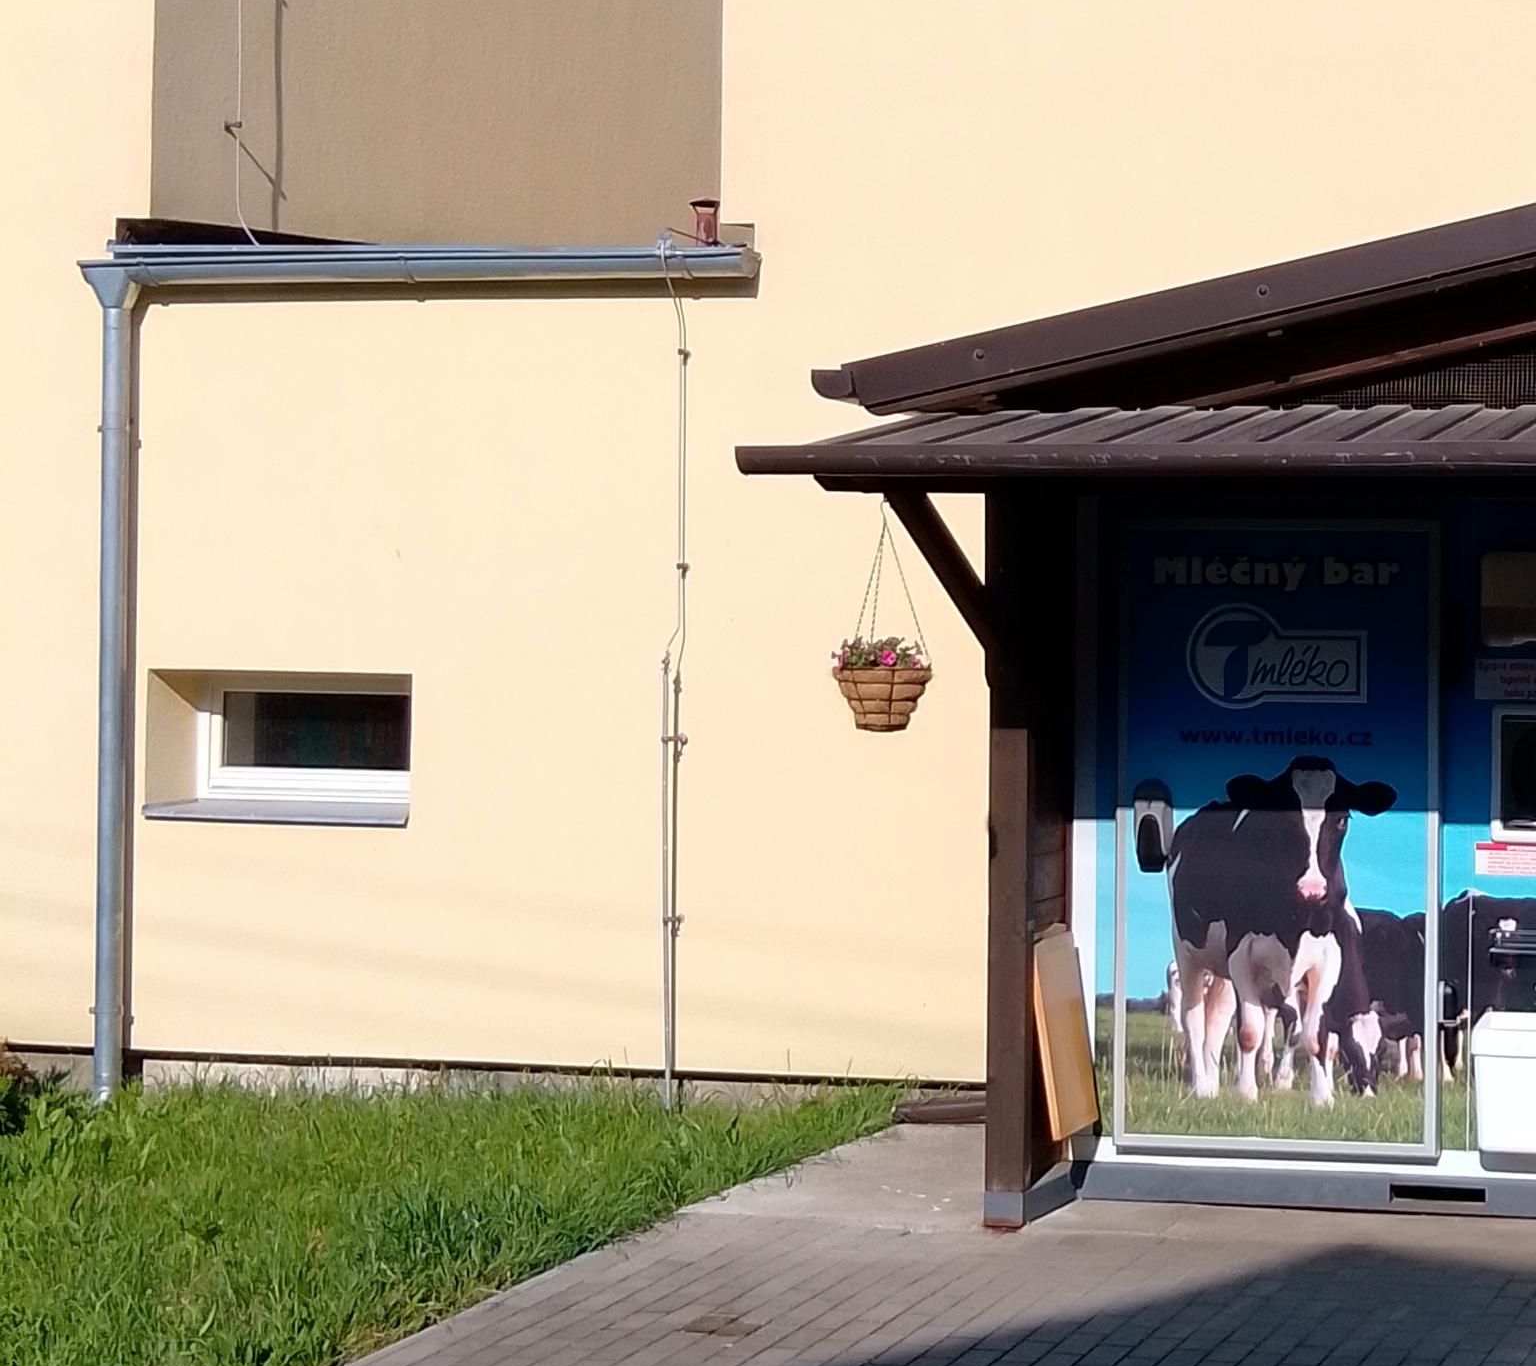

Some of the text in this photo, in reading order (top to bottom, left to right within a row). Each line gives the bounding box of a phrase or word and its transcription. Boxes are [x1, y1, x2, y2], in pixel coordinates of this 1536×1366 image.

[1152, 554, 1400, 592] Mléčný bar
[1178, 726, 1374, 747] www.tmleko.cz
